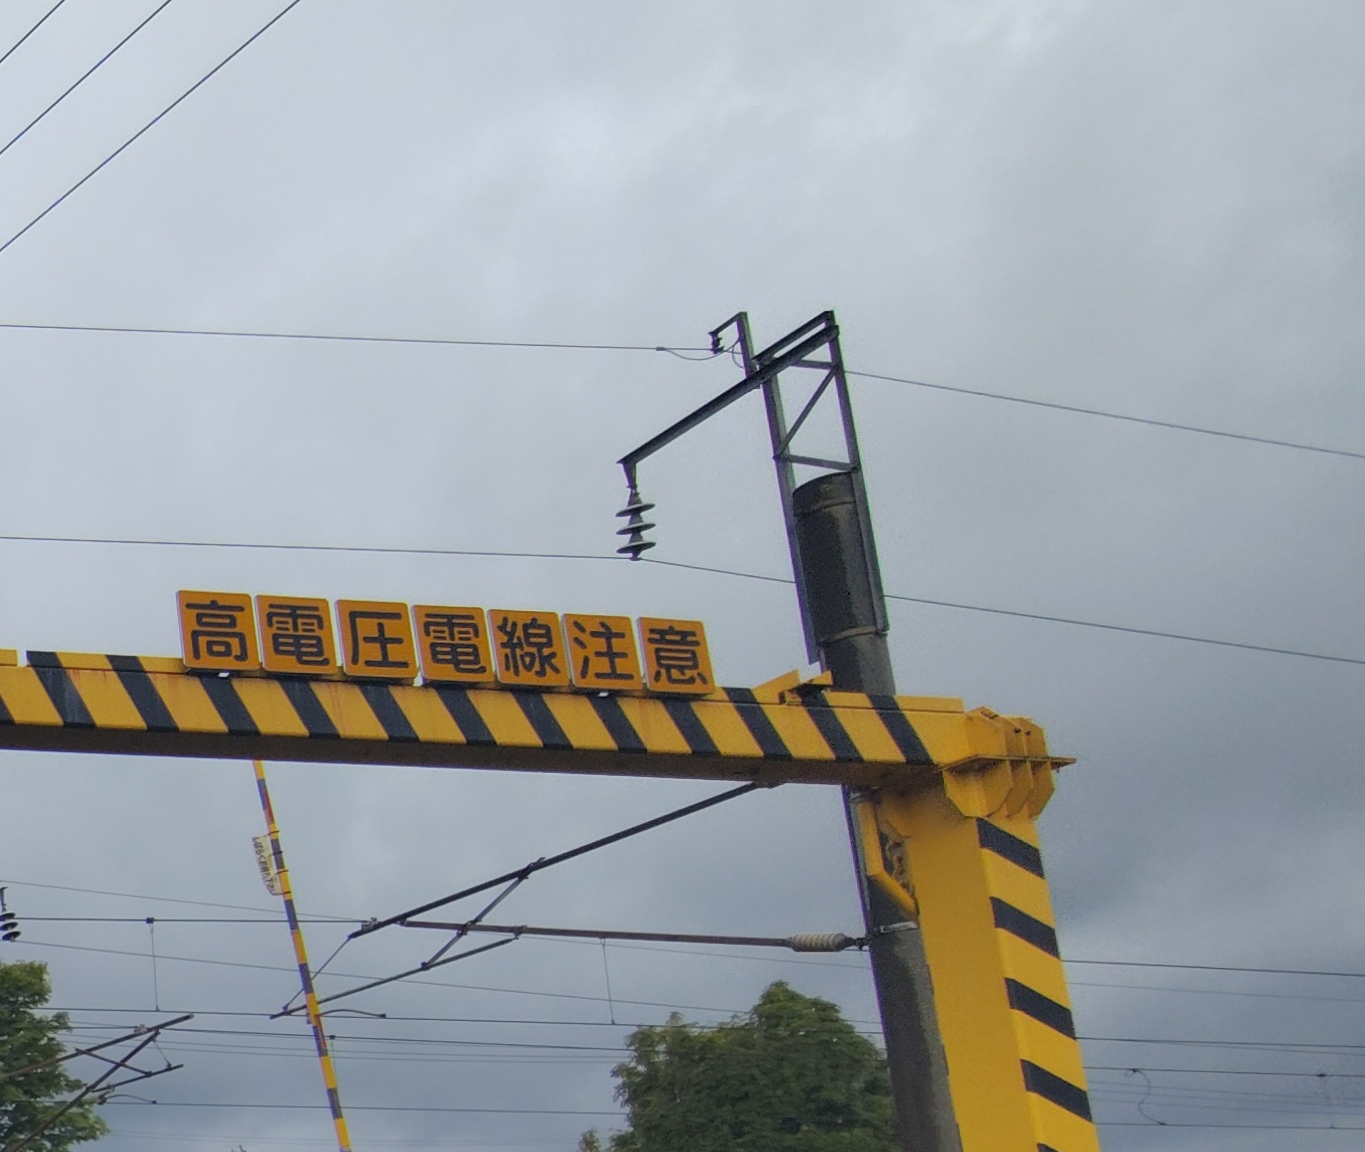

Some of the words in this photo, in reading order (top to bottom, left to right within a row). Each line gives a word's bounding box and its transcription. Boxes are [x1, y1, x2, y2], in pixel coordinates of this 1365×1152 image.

[184, 598, 709, 687] 高電圧電線注意
